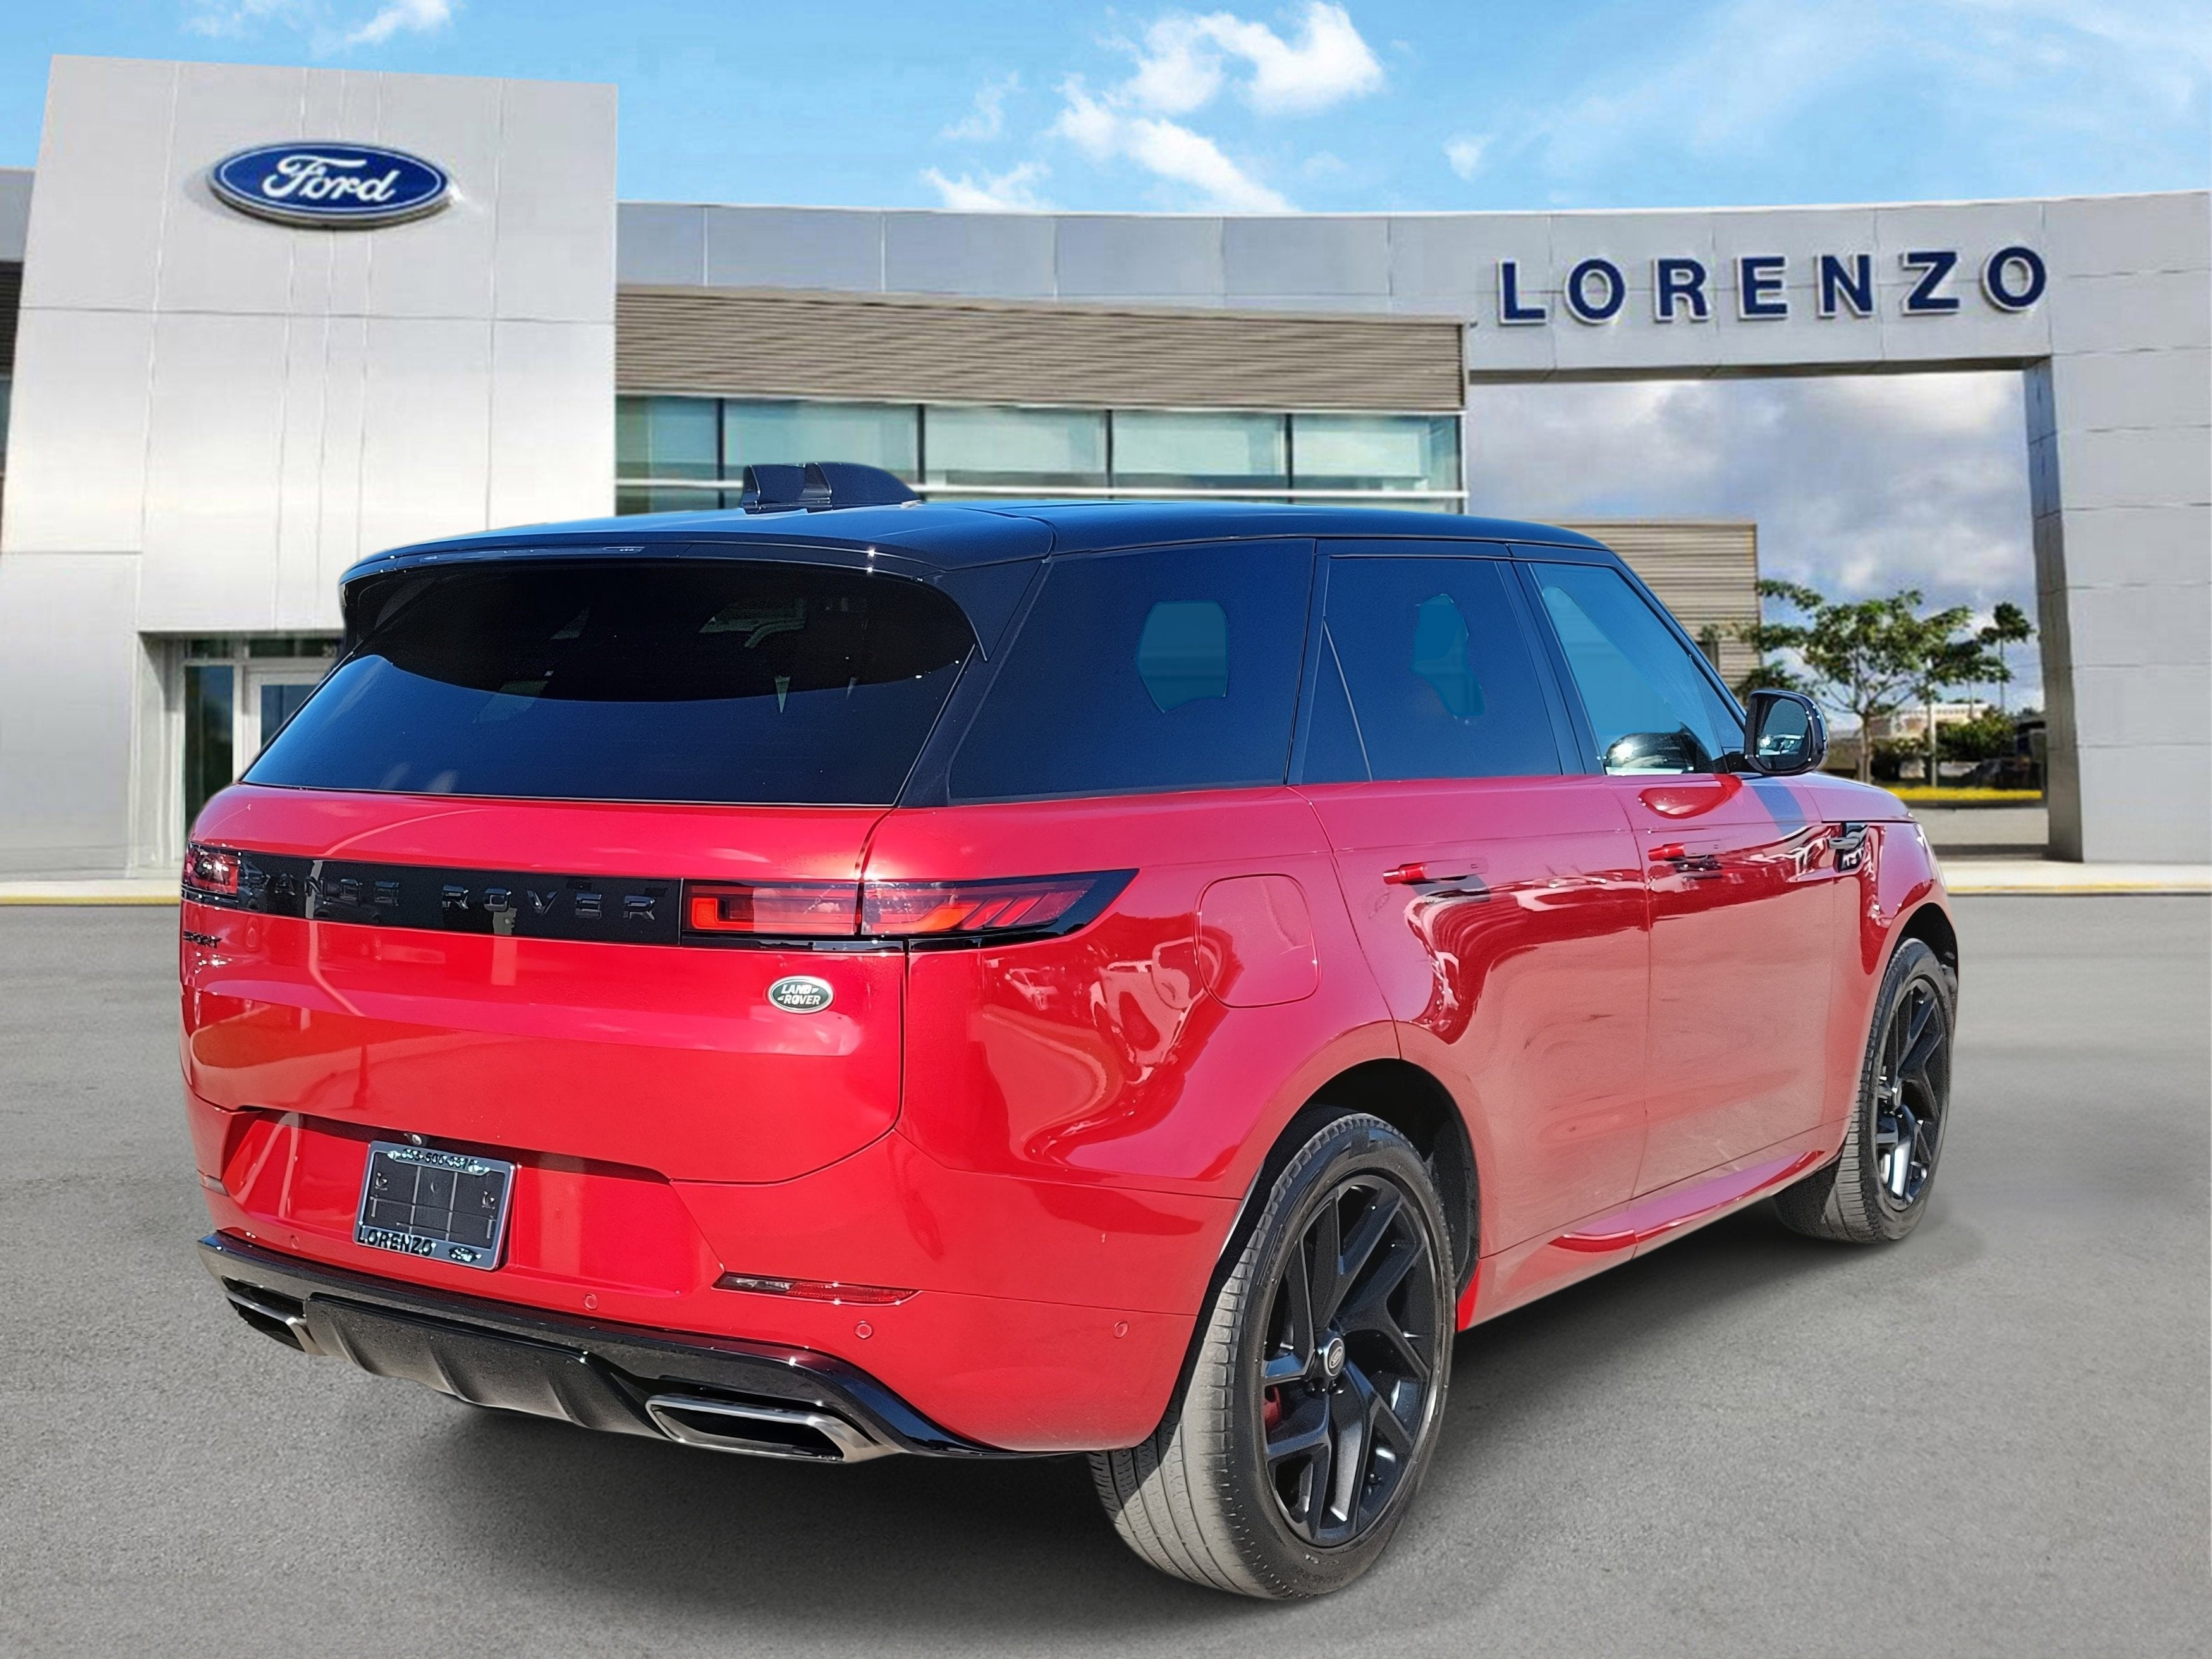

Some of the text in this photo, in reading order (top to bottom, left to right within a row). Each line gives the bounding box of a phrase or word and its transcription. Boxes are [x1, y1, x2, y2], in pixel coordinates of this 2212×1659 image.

[262, 154, 401, 202] Ford
[1498, 246, 2047, 325] LORENZO
[442, 885, 656, 921] ROVER
[781, 984, 812, 995] LAND
[783, 994, 821, 1005] ROVER
[357, 1226, 434, 1257] LORENZO
